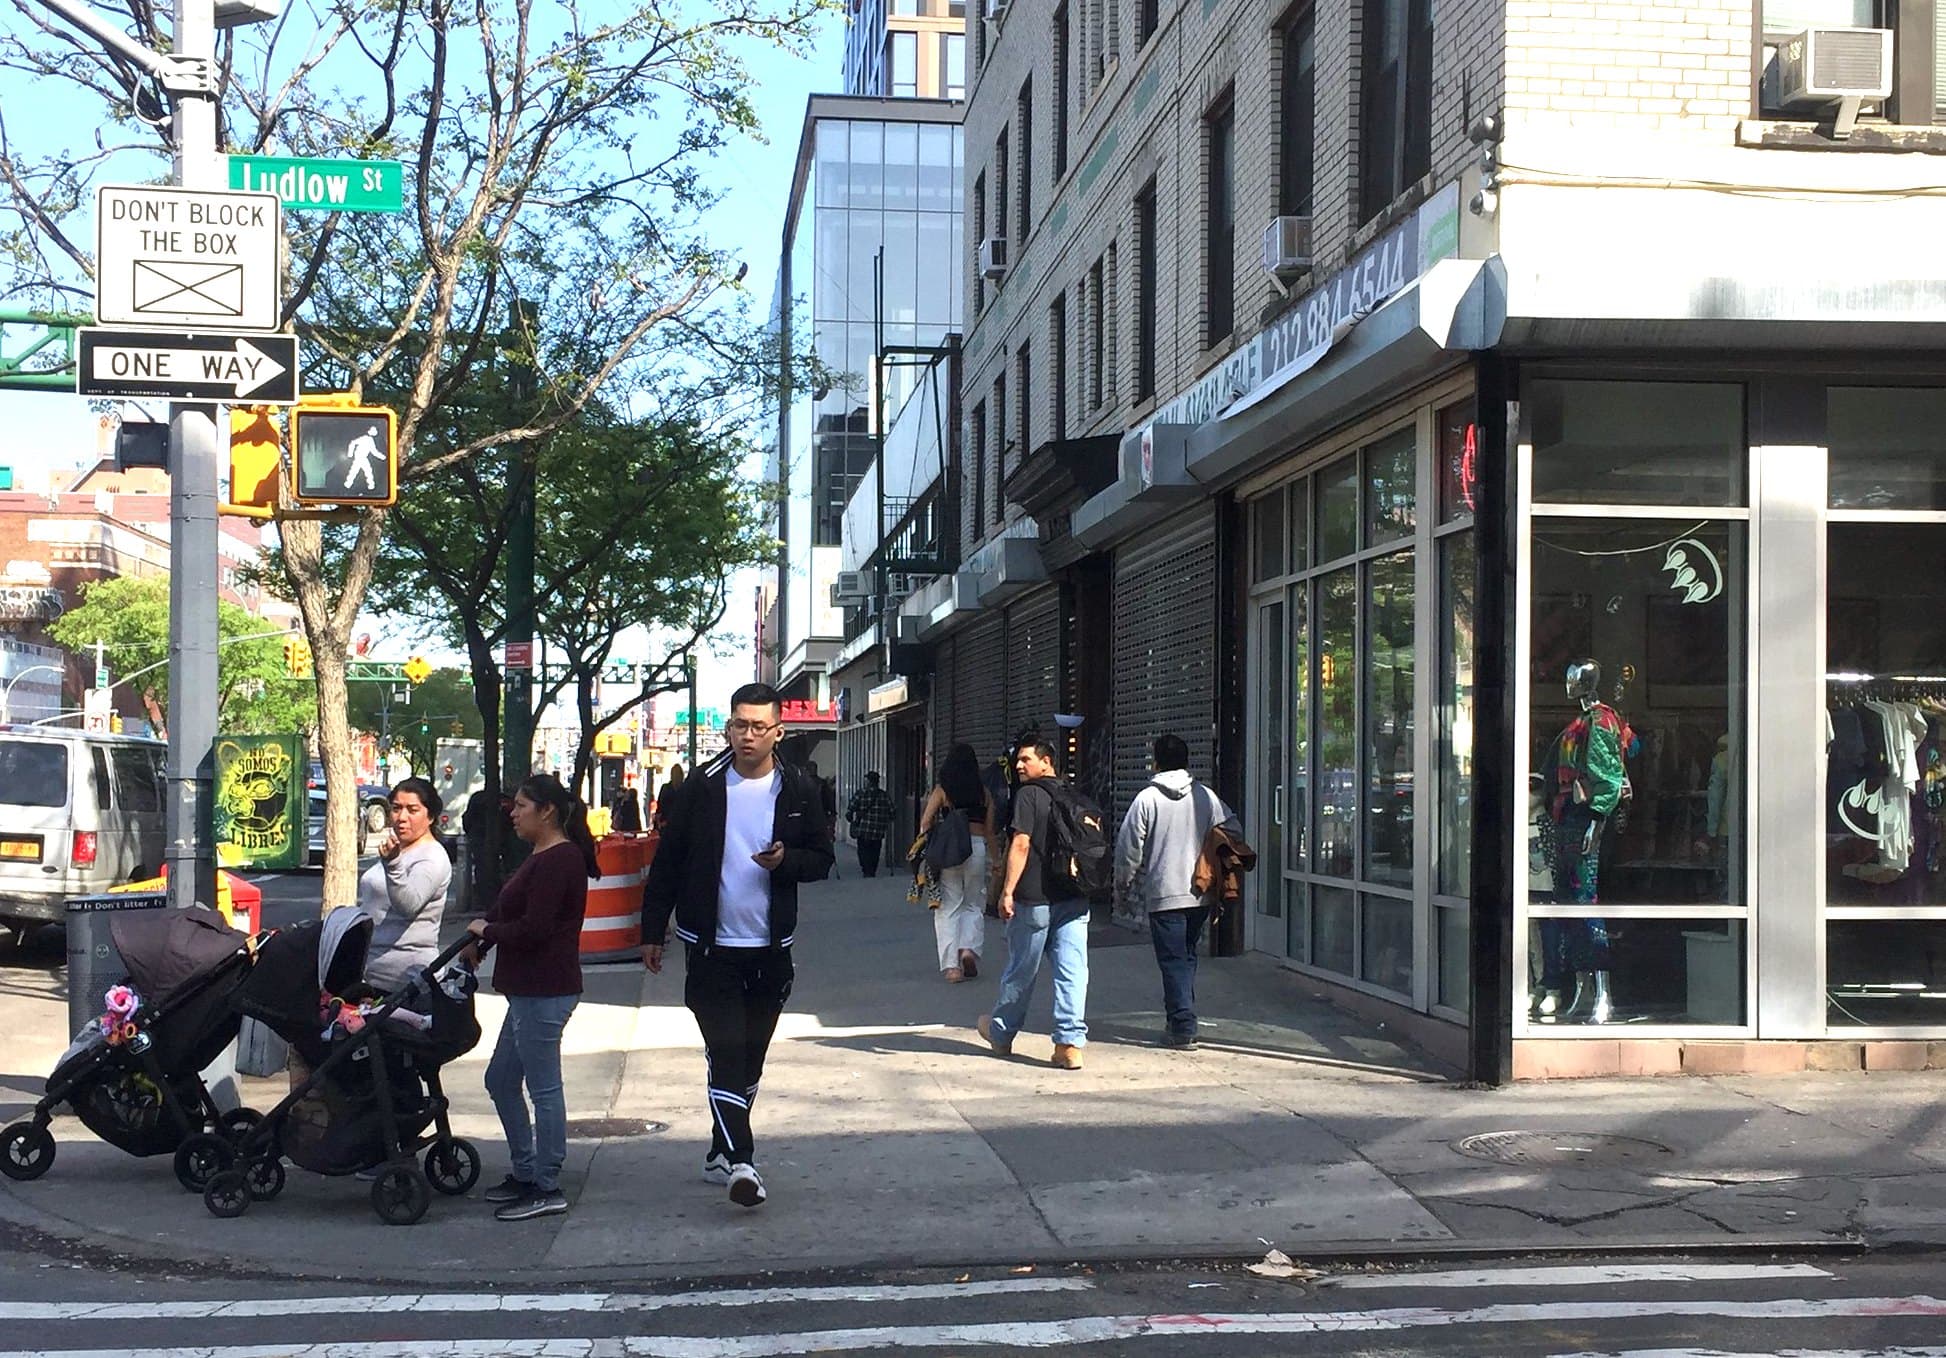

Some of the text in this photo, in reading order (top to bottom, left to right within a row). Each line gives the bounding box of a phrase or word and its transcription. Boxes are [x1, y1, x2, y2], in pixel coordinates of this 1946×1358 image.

[243, 162, 383, 203] Ludlow St
[112, 199, 265, 227] DON'T BLOCK
[140, 230, 237, 255] THE BOX
[1270, 312, 1302, 375] 212
[1349, 231, 1405, 310] 6544
[111, 352, 263, 381] ONE WAY
[238, 756, 277, 773] SOMOS
[231, 822, 286, 849] LIBRES
[124, 900, 148, 908] litter
